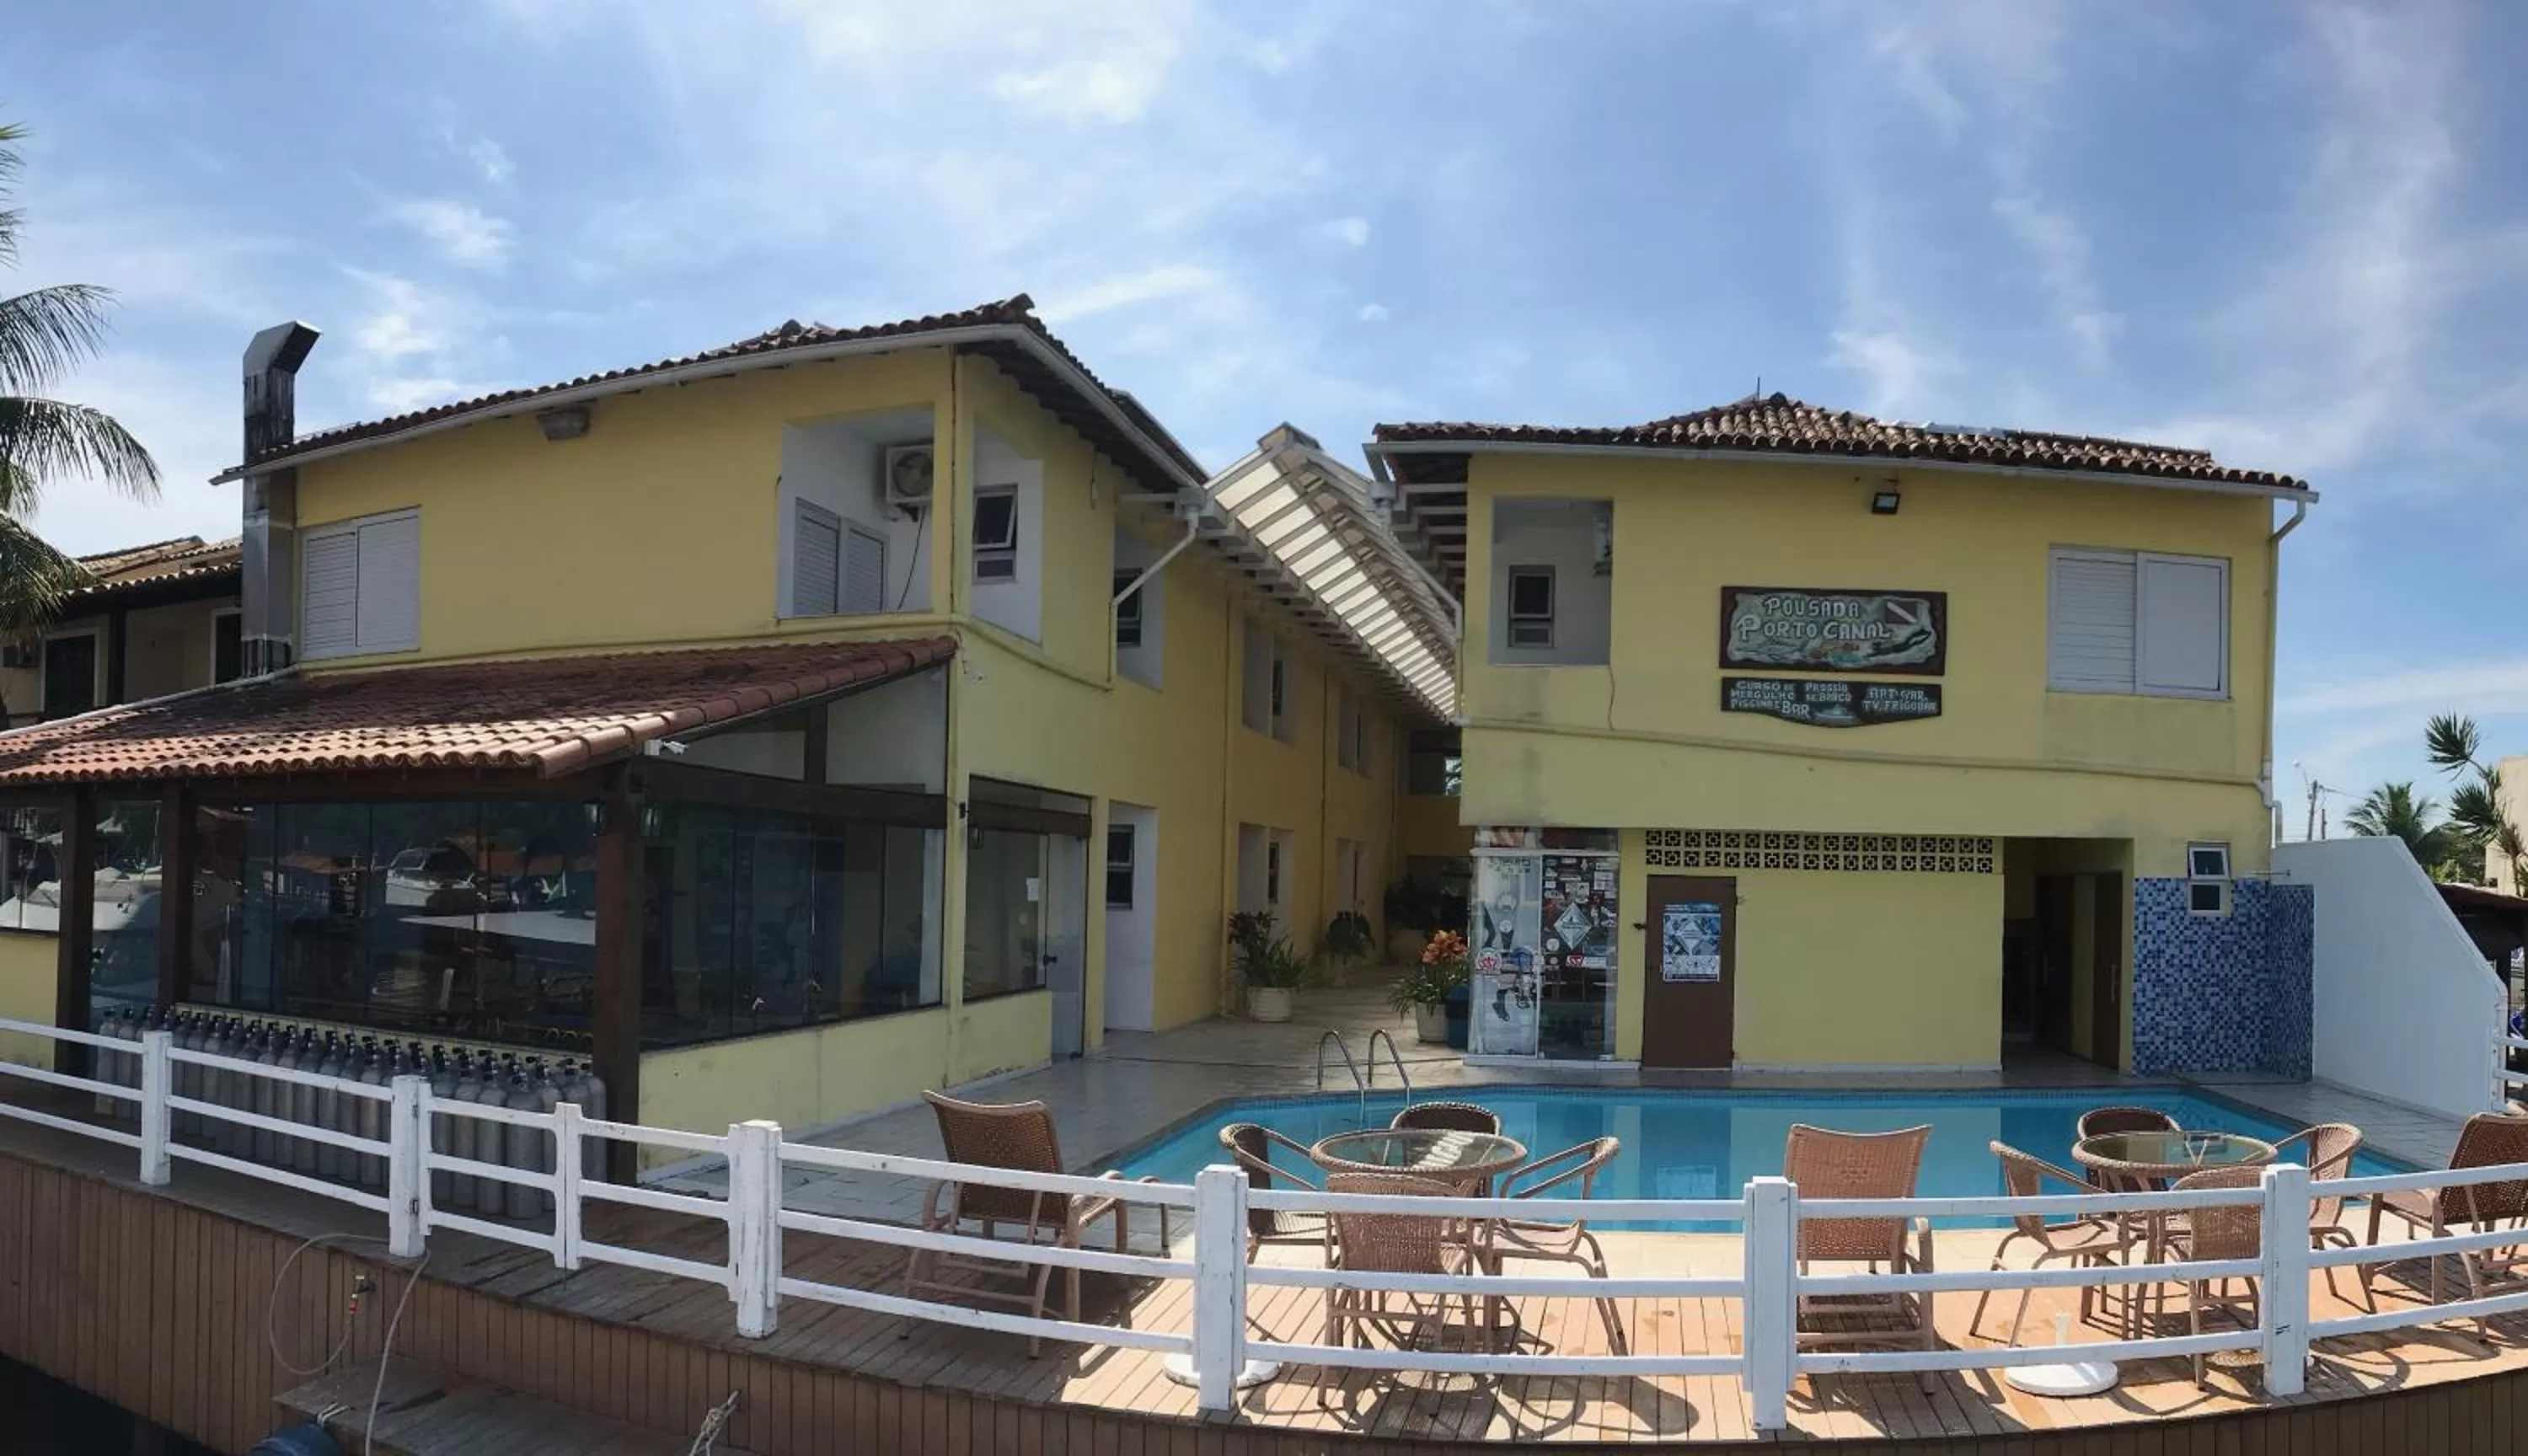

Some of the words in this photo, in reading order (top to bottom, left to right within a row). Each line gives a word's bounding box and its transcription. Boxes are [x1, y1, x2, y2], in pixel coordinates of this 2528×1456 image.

[1764, 597, 1859, 617] POUSADA
[1736, 614, 1818, 641] PORTO
[1823, 621, 1891, 640] CANAL
[1782, 701, 1810, 716] BAR
